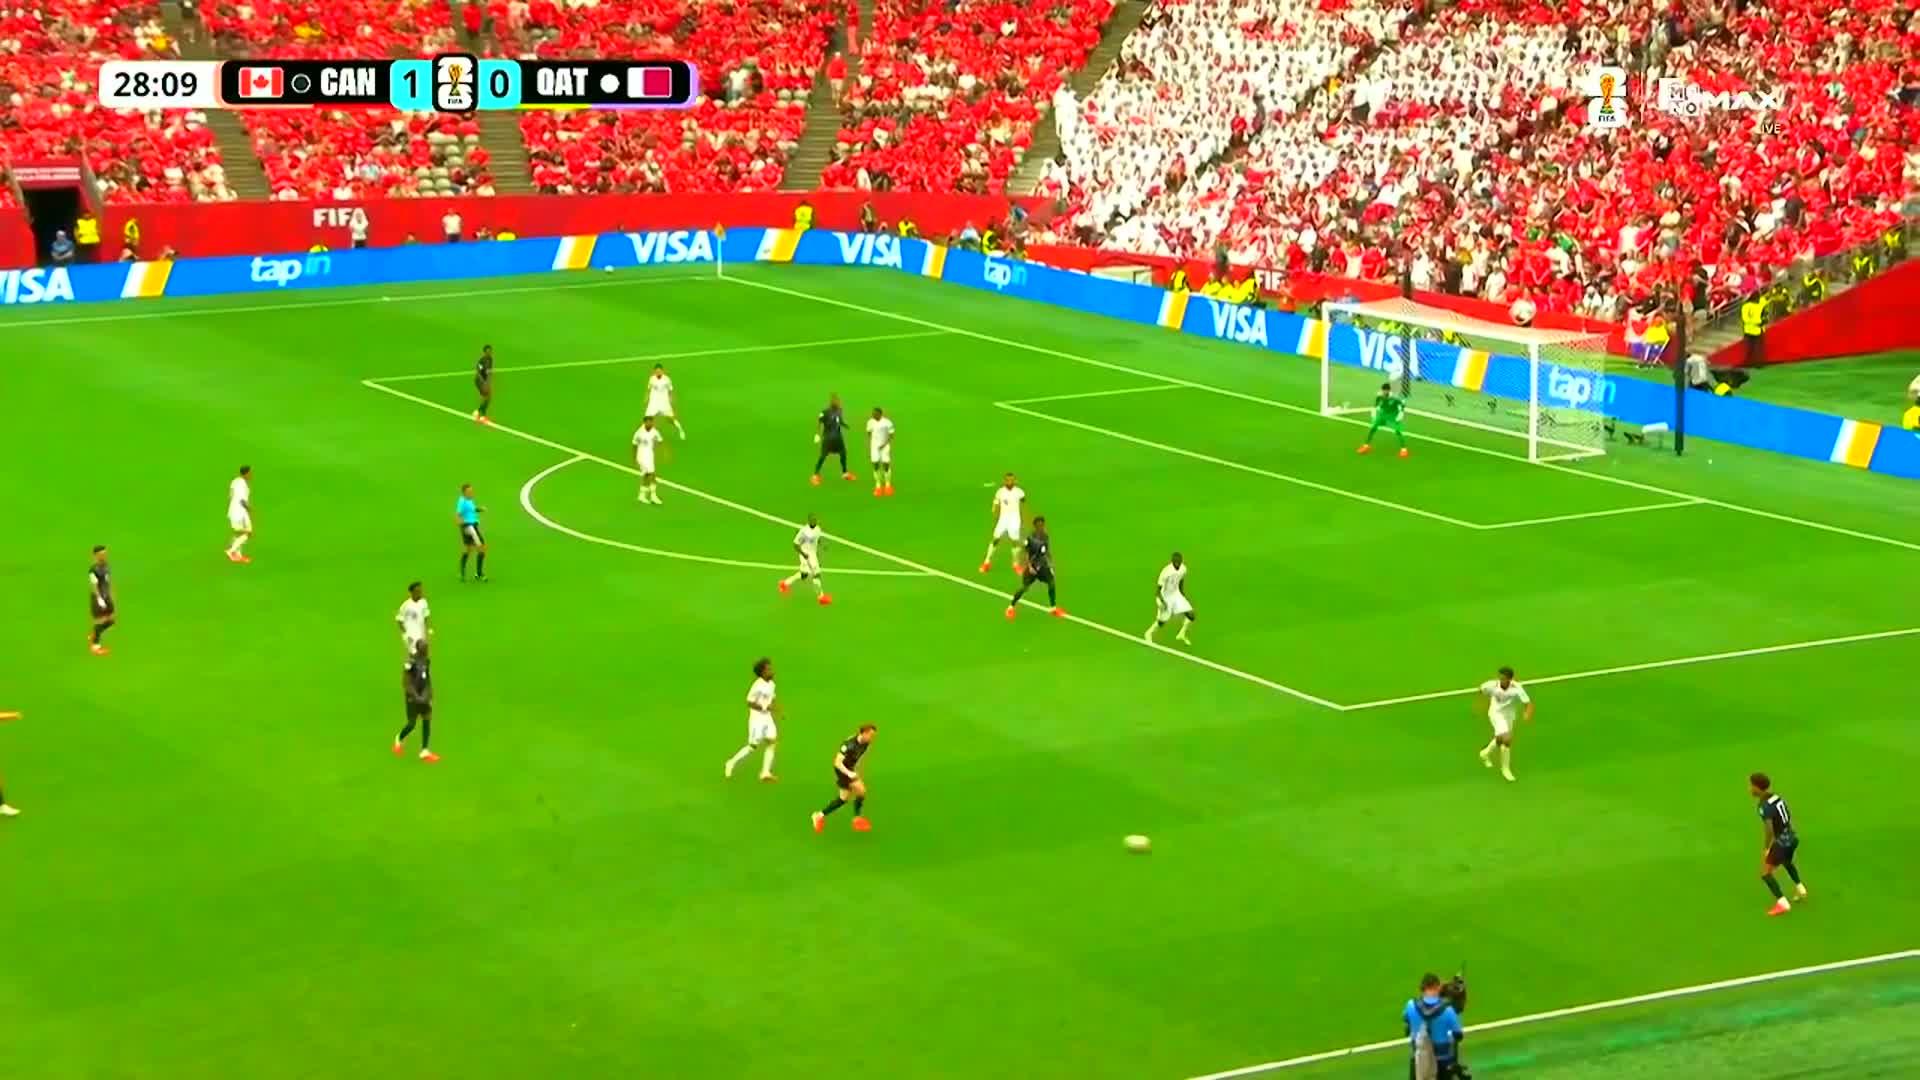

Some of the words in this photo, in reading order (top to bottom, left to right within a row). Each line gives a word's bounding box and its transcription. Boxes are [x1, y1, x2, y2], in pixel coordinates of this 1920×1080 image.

[313, 207, 356, 228] FIF
[625, 230, 714, 264] VISA
[832, 232, 903, 269] VISA
[1253, 269, 1284, 292] FIF
[1208, 299, 1268, 347] VISA
